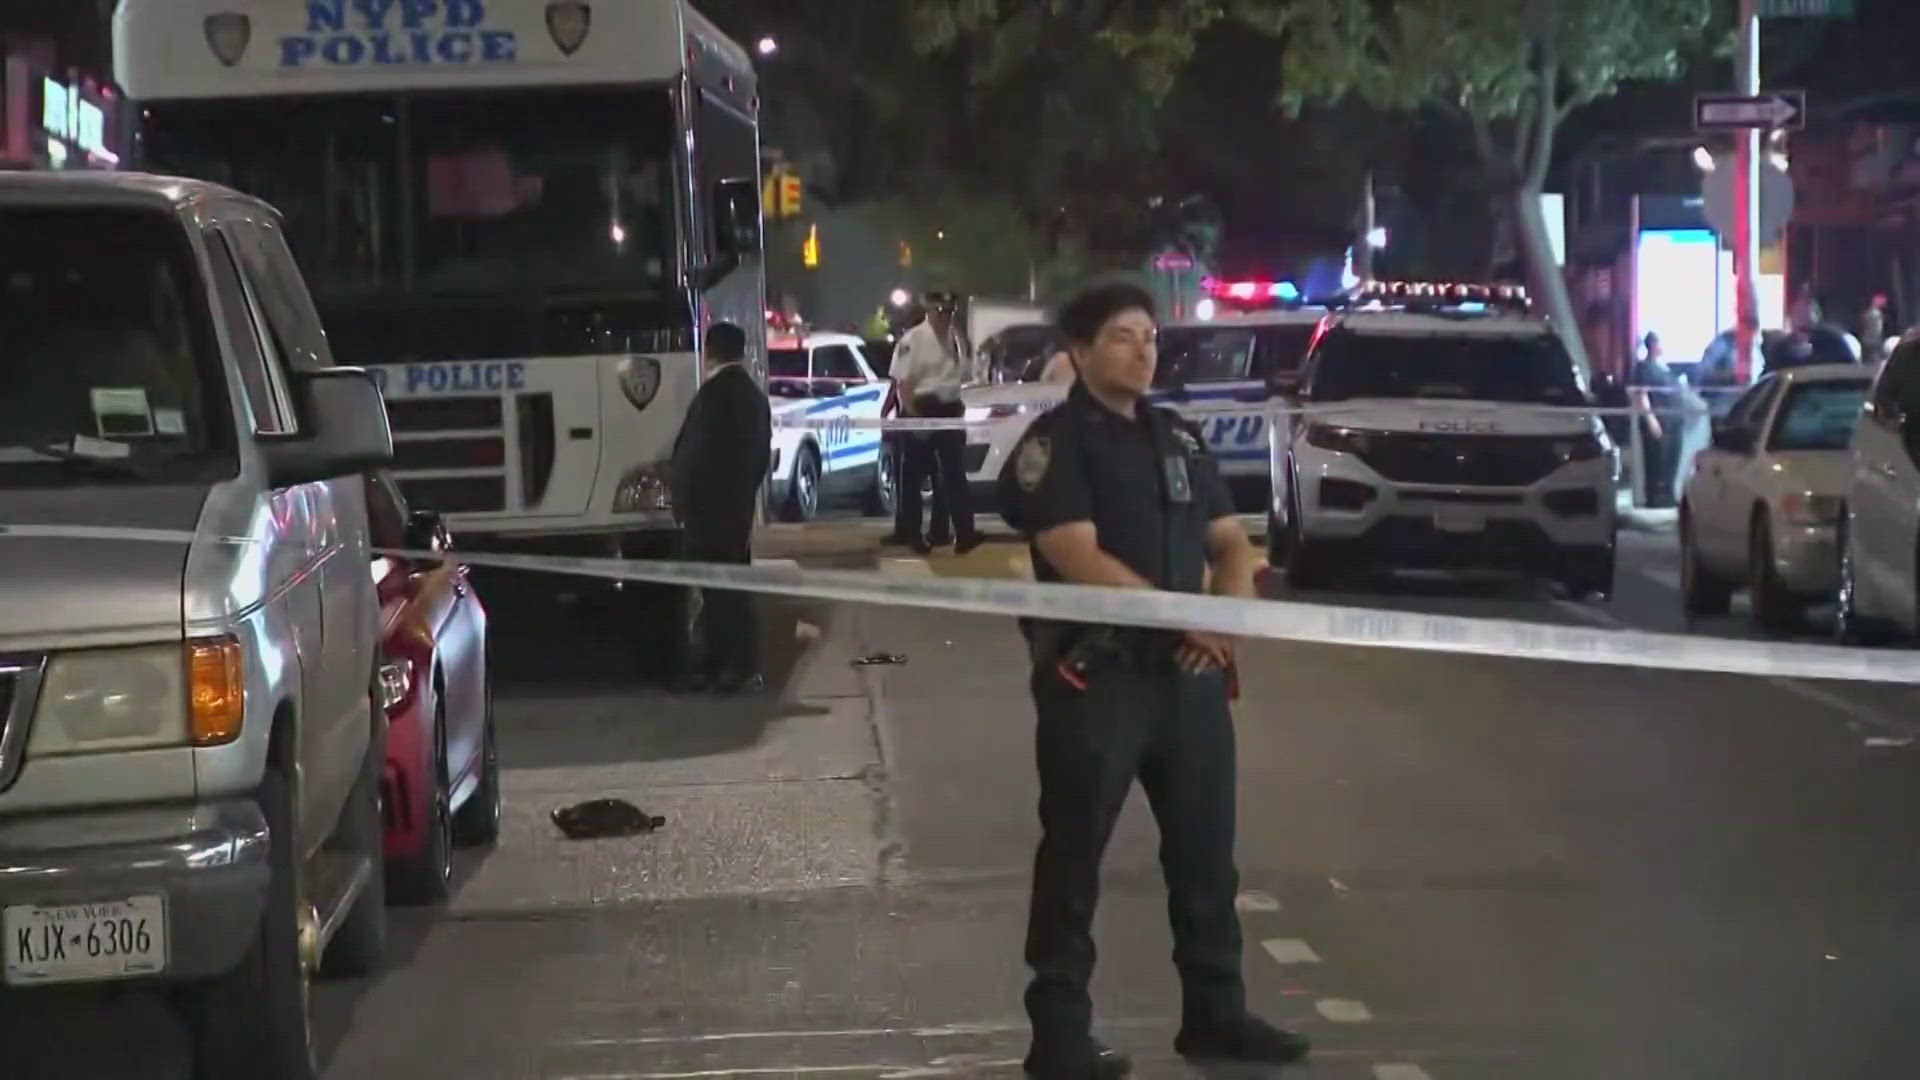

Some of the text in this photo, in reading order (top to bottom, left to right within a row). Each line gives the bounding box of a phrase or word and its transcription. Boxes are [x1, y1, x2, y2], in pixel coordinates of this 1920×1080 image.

[306, 0, 485, 30] NYPD
[279, 32, 515, 66] POLICE
[407, 363, 526, 391] POLICE
[1201, 415, 1264, 445] PD
[18, 918, 150, 963] KJX 6306
